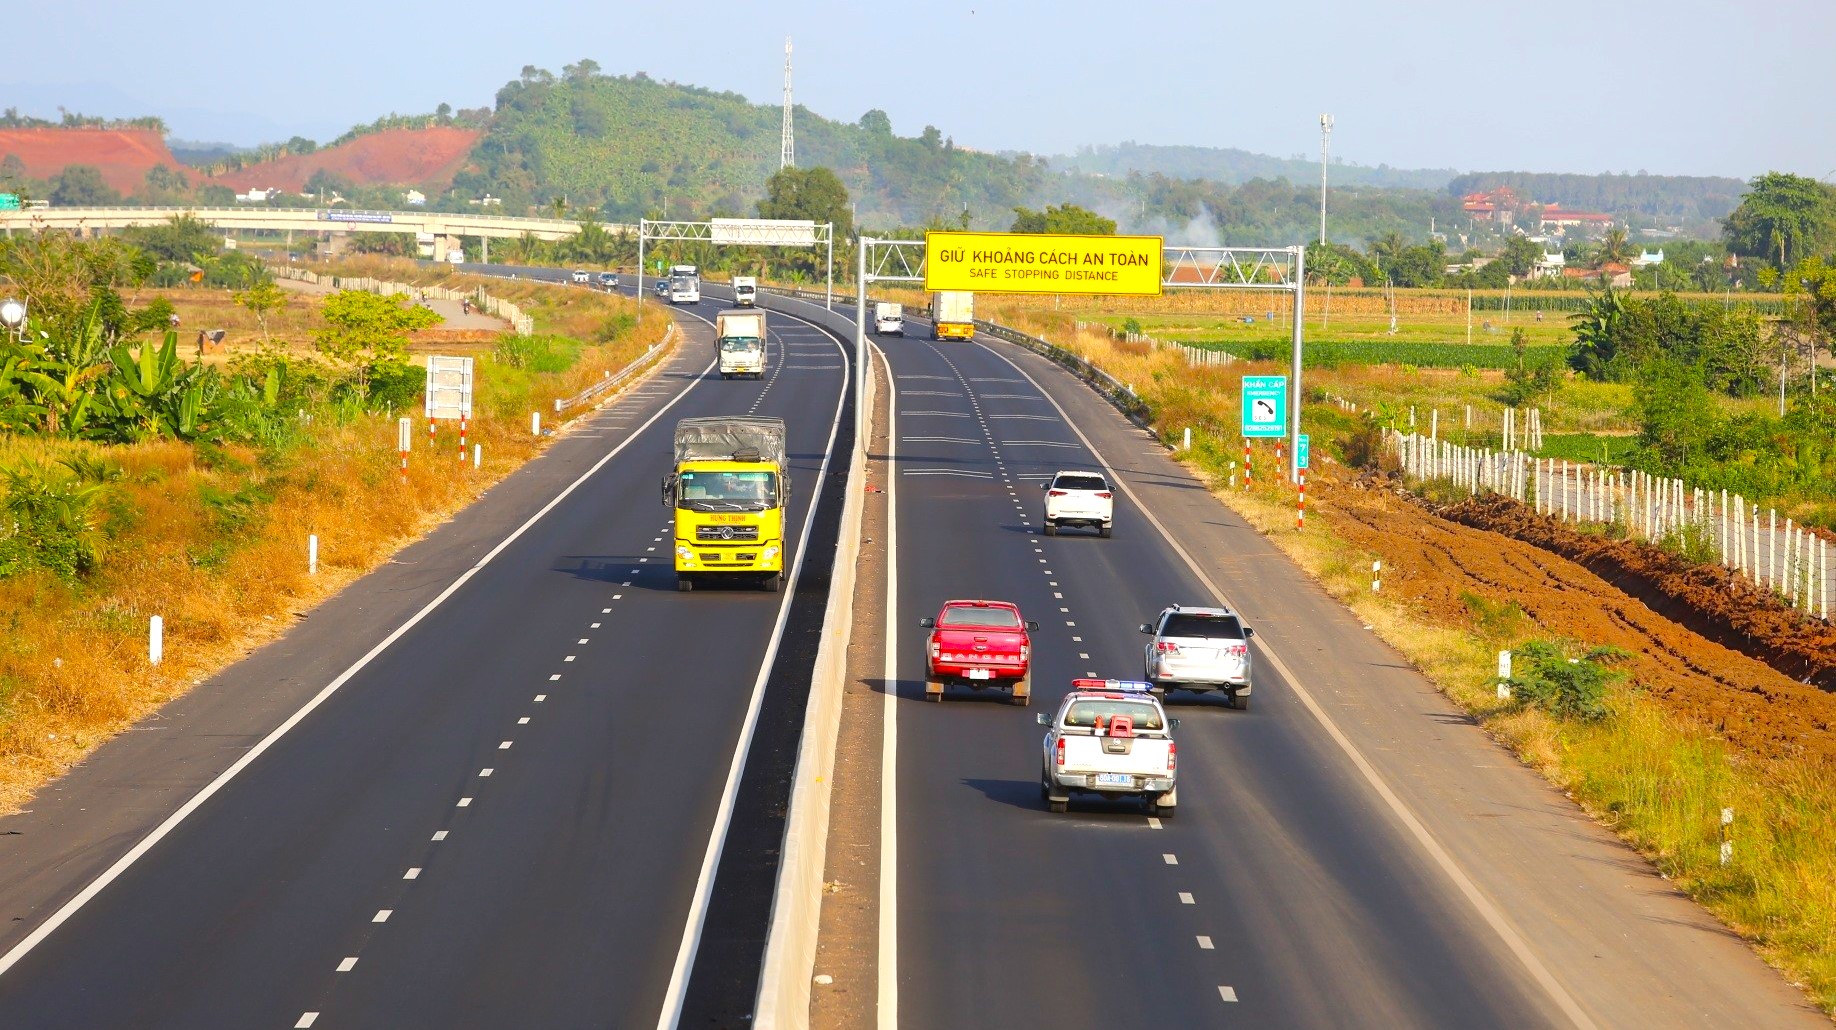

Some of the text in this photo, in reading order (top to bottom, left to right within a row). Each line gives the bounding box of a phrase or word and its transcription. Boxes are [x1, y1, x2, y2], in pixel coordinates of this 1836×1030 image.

[940, 247, 1148, 267] GIỮ KHOẢNG CÁCH AN TOÀN
[969, 268, 1119, 281] SAFE STOPPING DISTANCE
